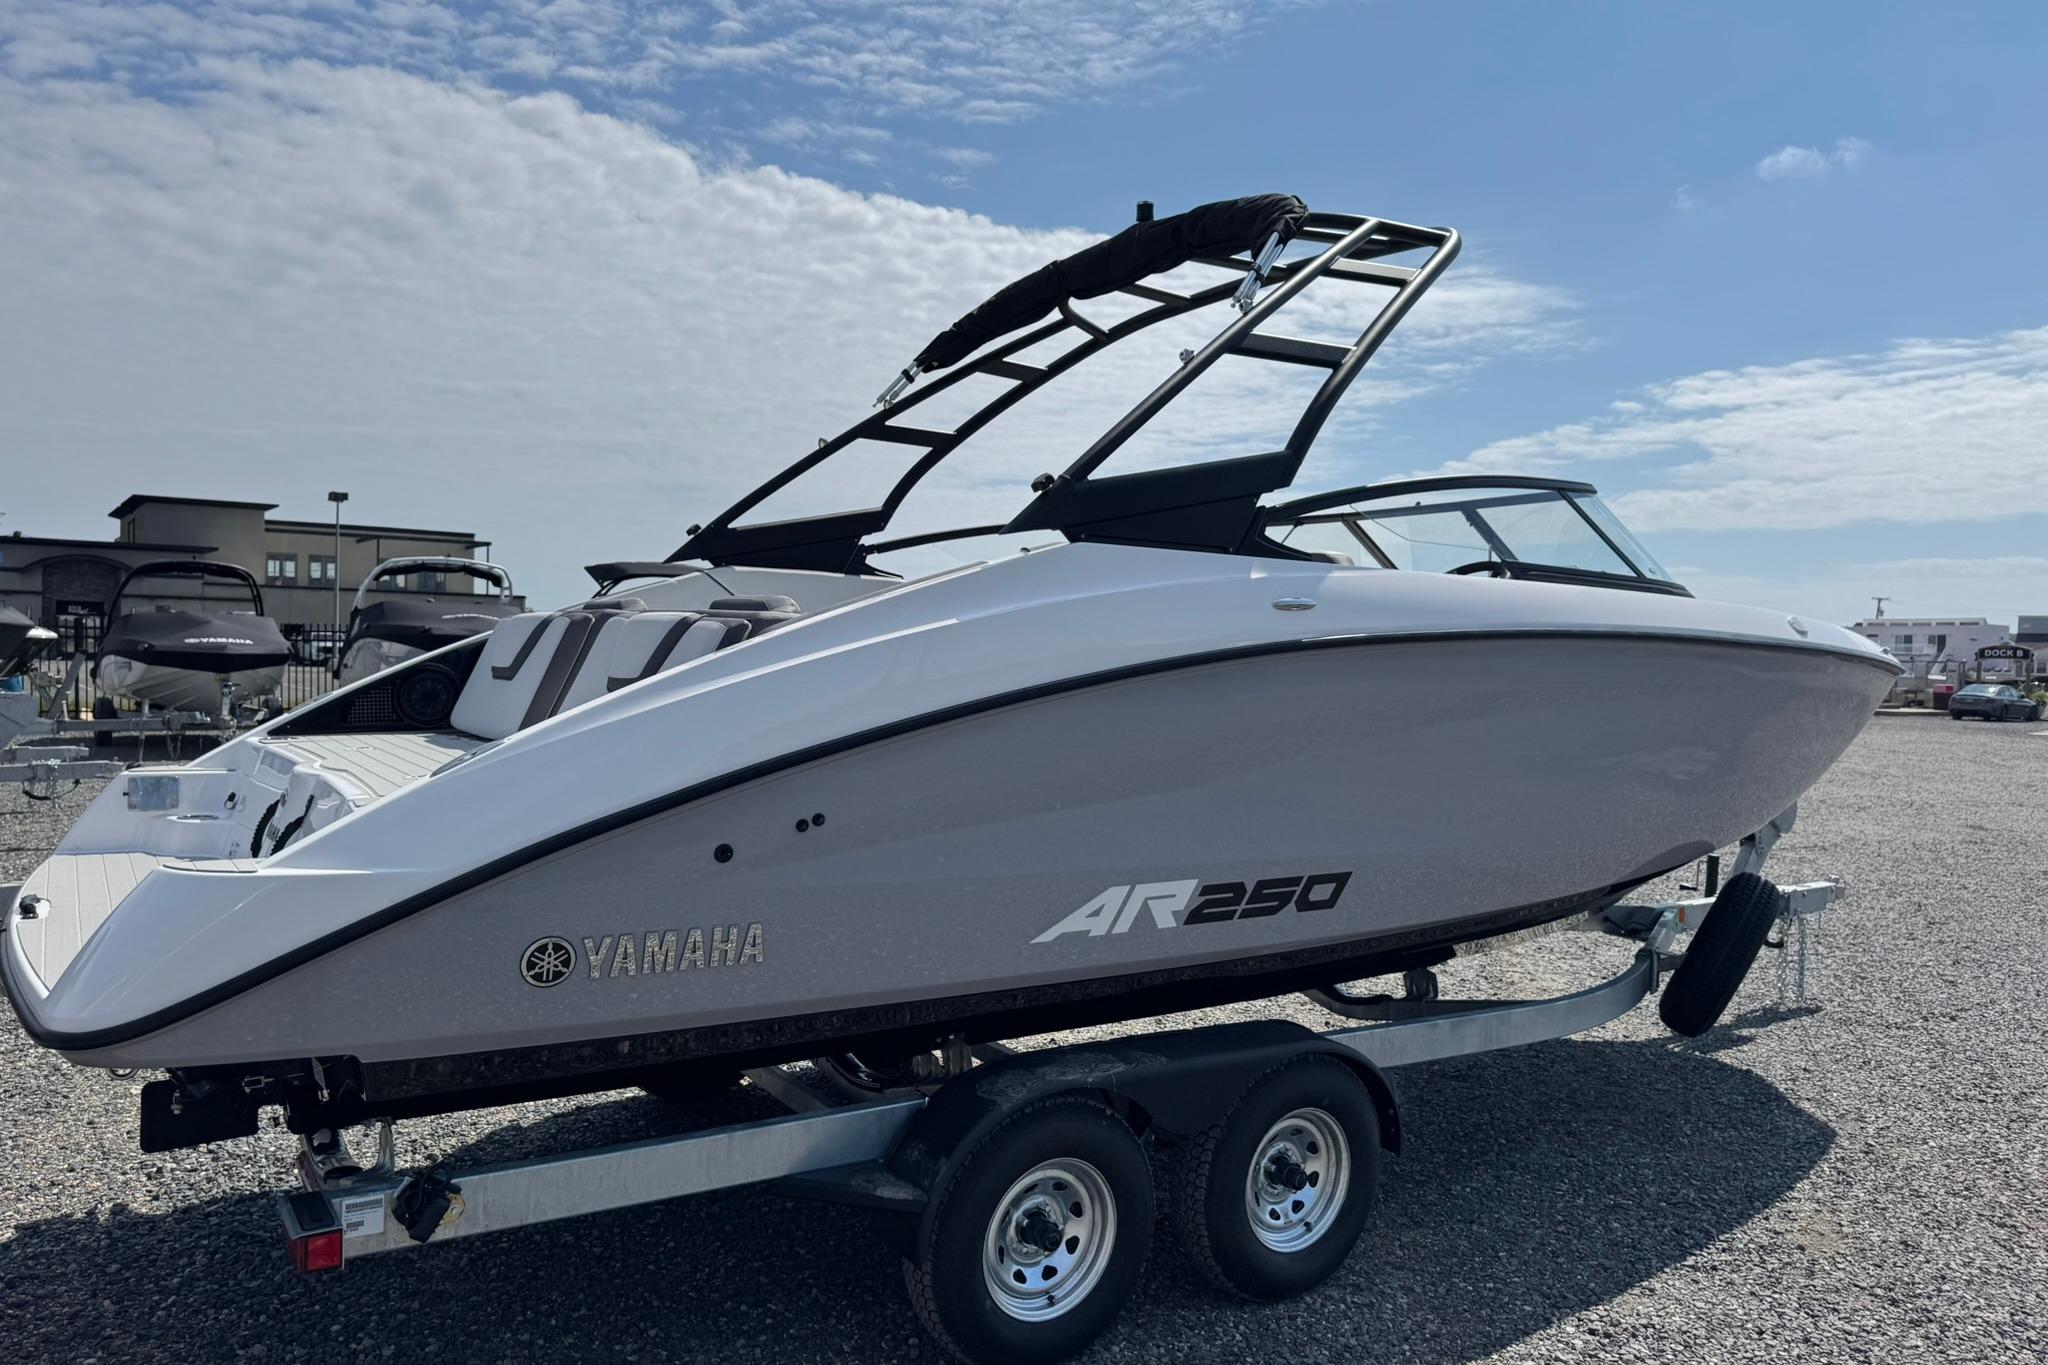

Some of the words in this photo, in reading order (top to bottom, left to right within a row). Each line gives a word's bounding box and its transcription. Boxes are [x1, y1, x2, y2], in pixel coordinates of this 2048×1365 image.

[199, 637, 254, 645] YAMAHA
[1984, 649, 2013, 657] DOCK
[583, 921, 765, 979] YAMAHA
